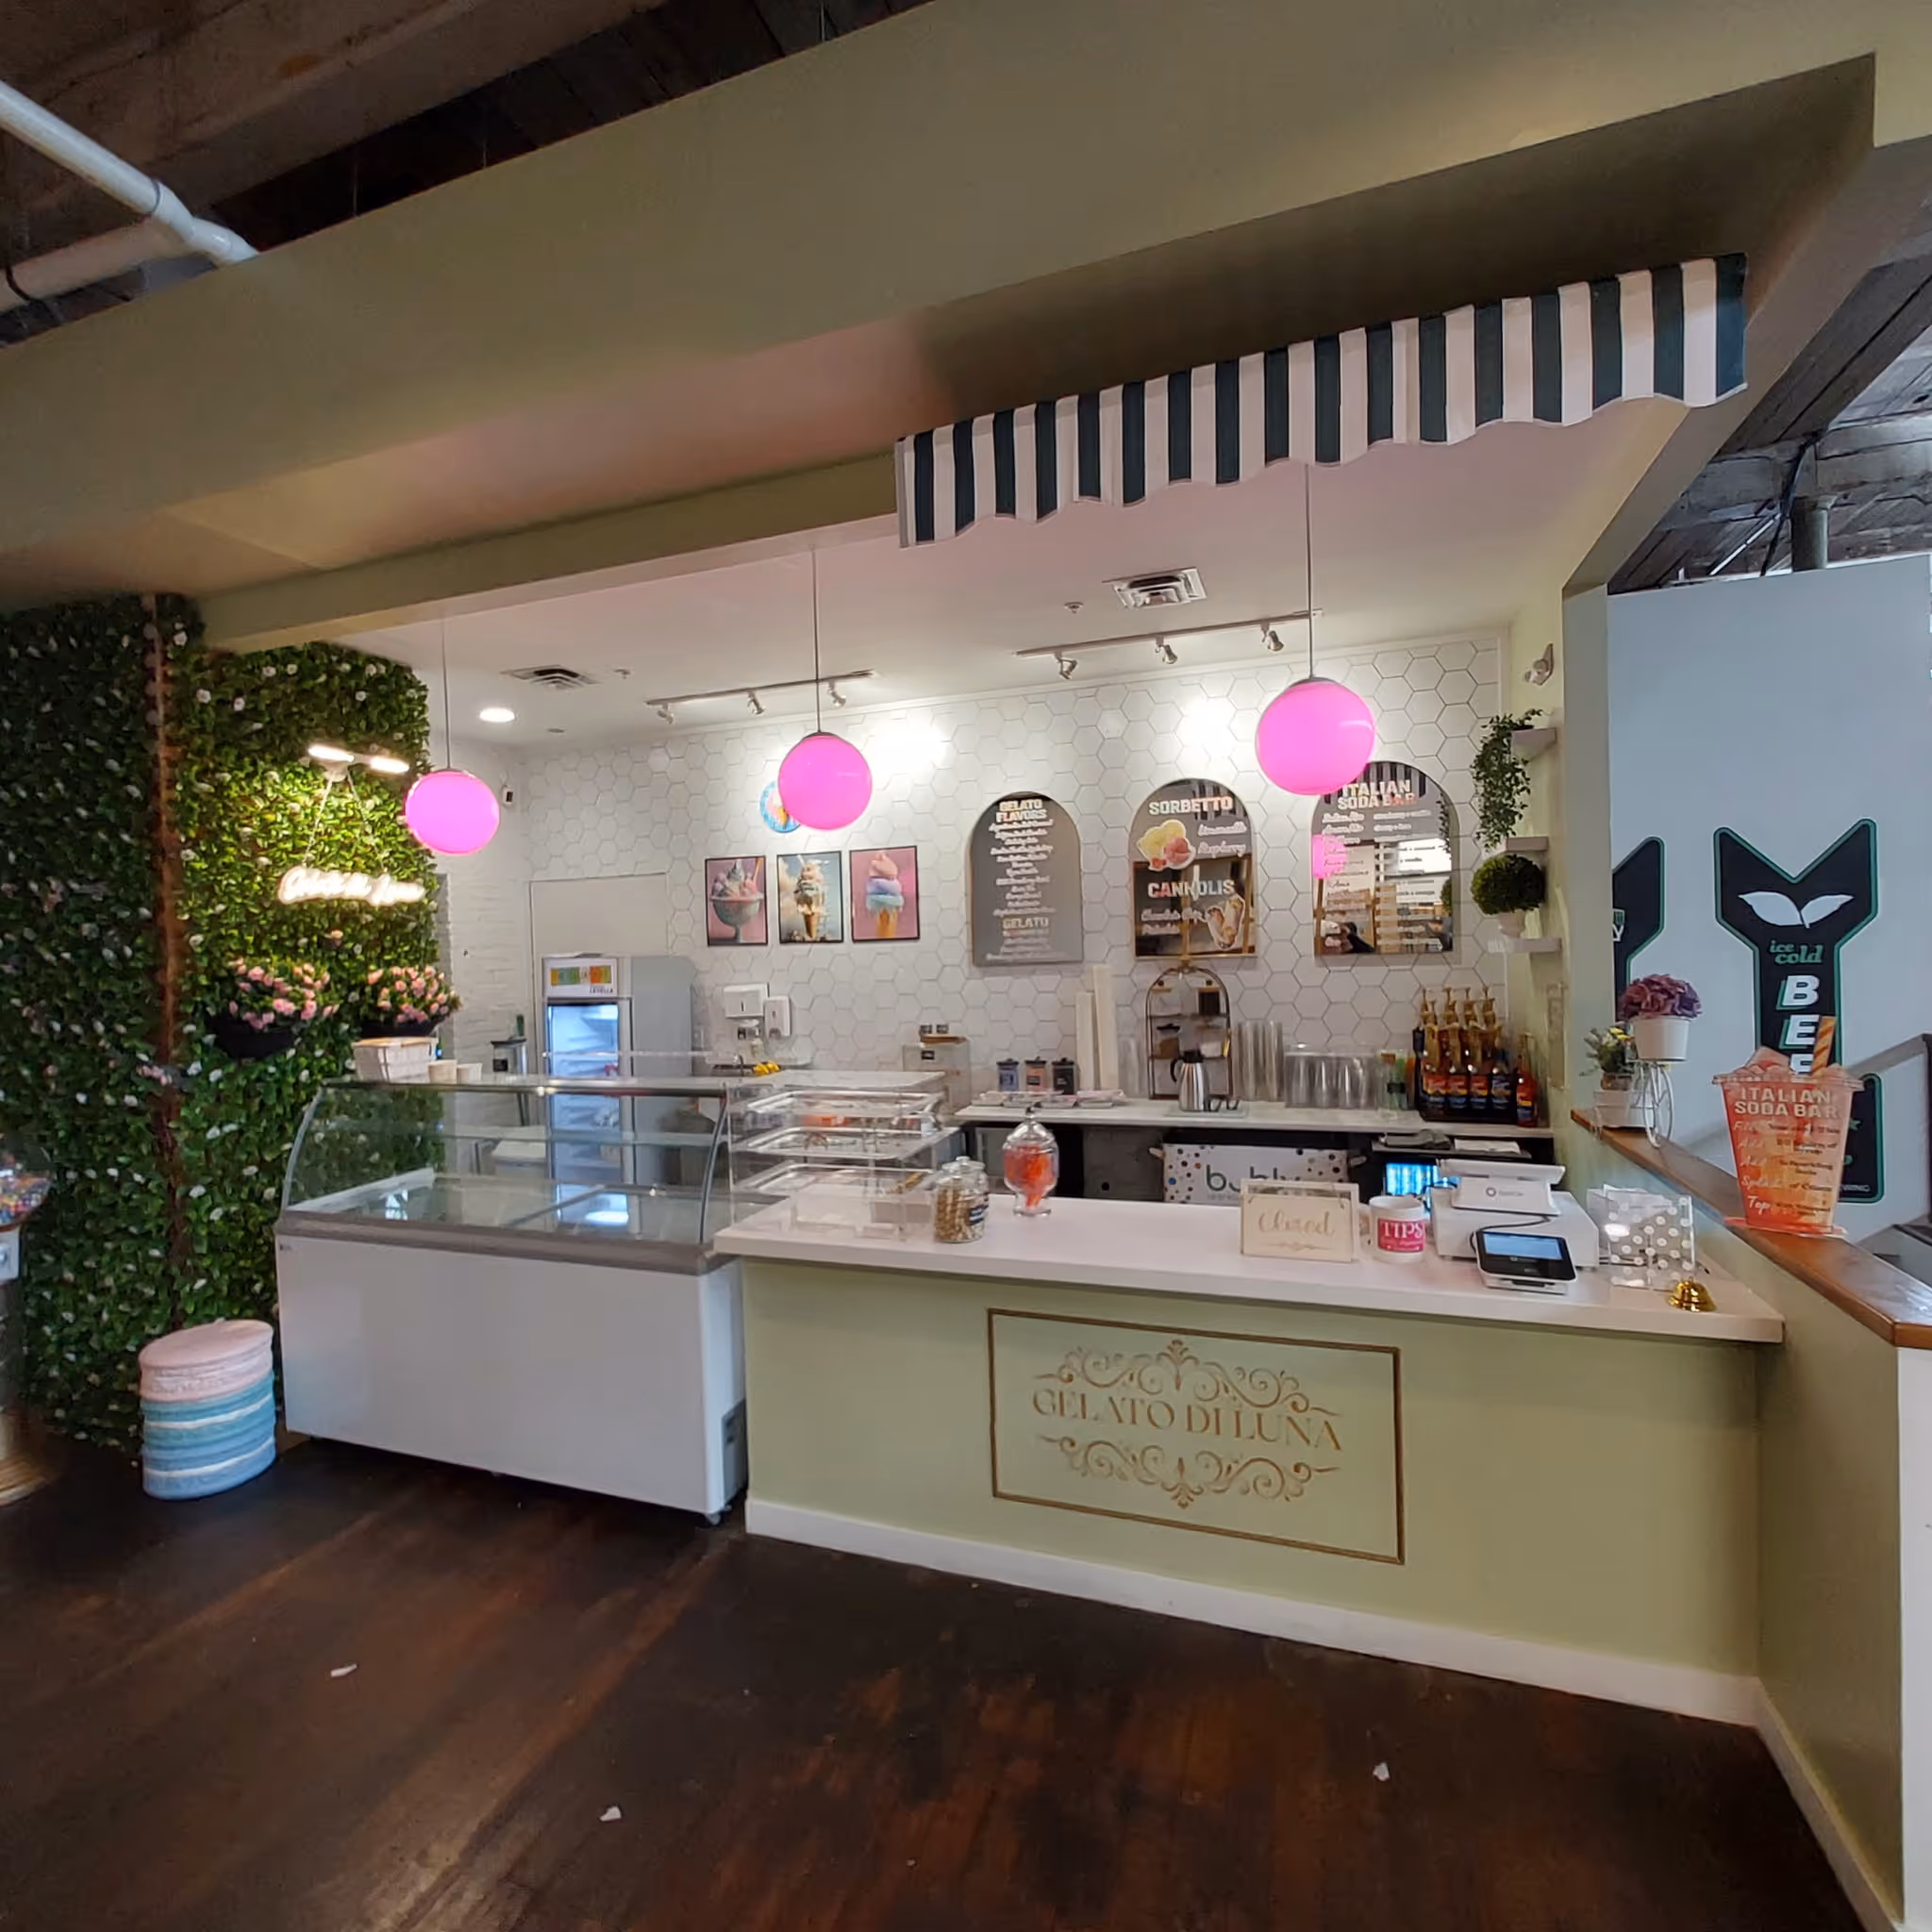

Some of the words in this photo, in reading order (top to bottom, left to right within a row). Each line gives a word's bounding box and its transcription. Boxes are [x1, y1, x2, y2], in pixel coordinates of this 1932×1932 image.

[1341, 780, 1410, 798] ITALIAN
[999, 799, 1043, 811] GELATO
[1149, 796, 1233, 815] SORBETTO
[1338, 794, 1380, 809] SODA
[1382, 792, 1416, 807] BAR
[996, 809, 1047, 823] FLAVORS
[1003, 917, 1049, 928] GELATO
[1770, 941, 1794, 953] ice
[1774, 945, 1823, 964] cold
[1741, 1087, 1831, 1104] ITALIAN
[1734, 1101, 1789, 1116] SODA
[1793, 1104, 1838, 1119] BAR
[1382, 1222, 1424, 1239] TIPS
[1033, 1389, 1175, 1430] GELATO
[1186, 1404, 1222, 1437] DI
[1234, 1409, 1341, 1452] LUNA
